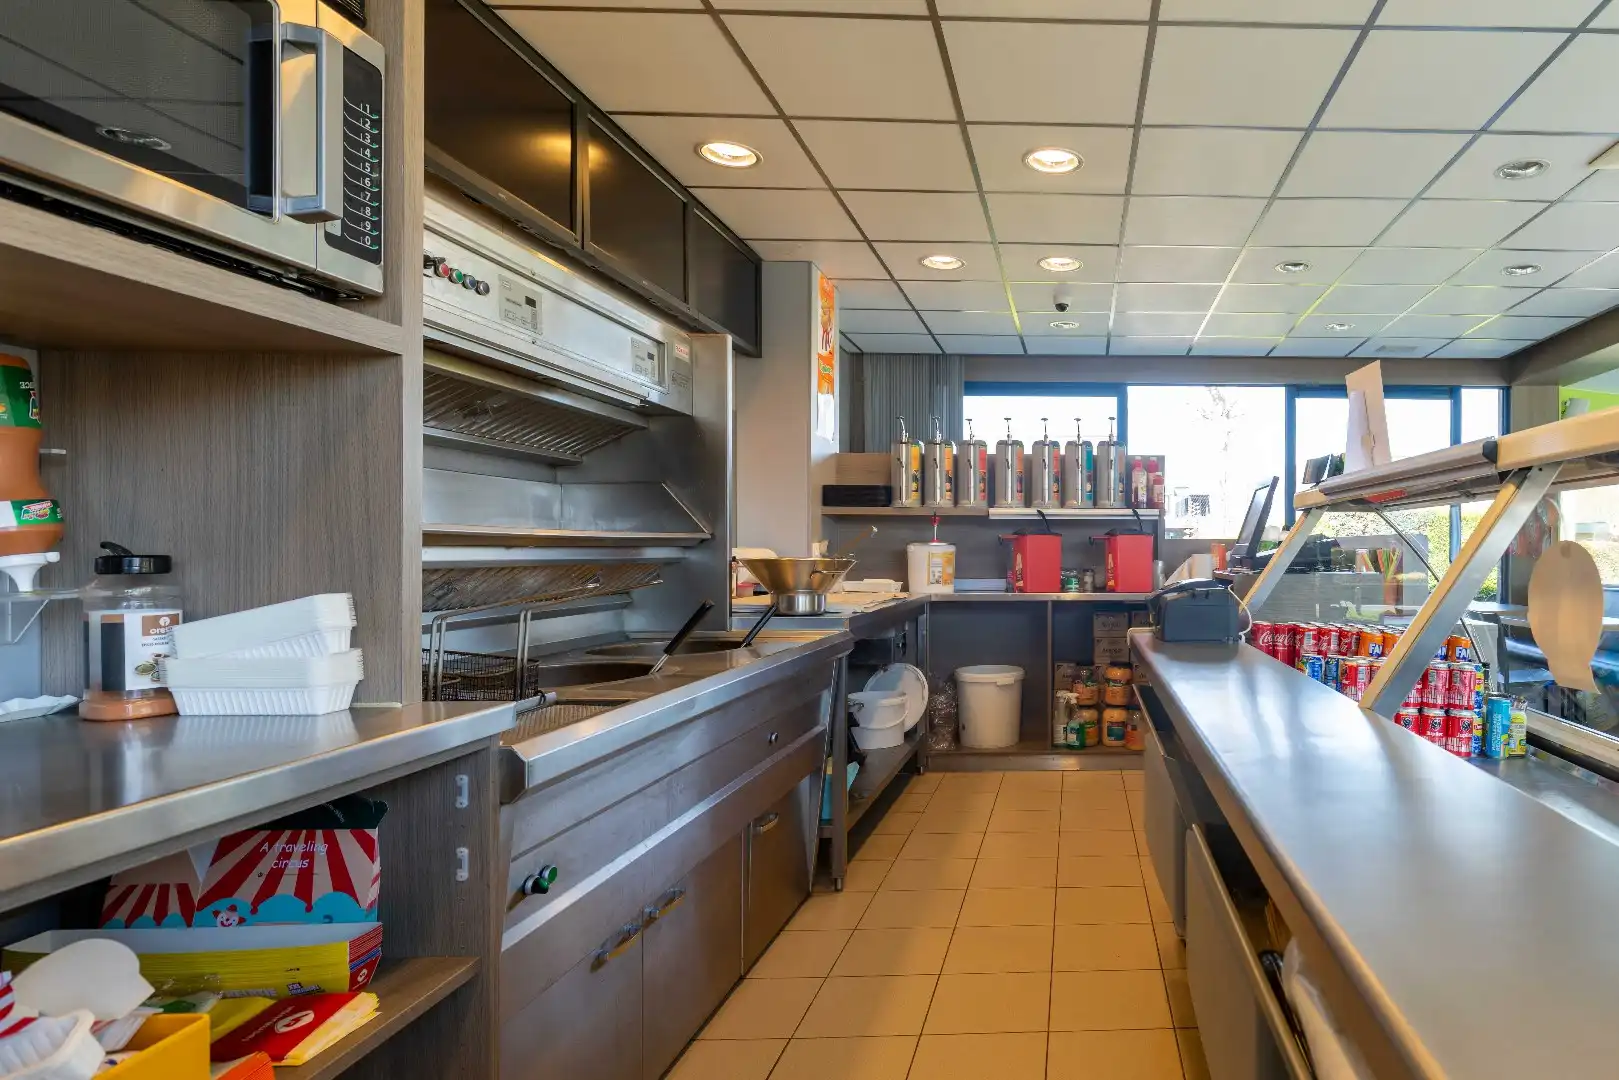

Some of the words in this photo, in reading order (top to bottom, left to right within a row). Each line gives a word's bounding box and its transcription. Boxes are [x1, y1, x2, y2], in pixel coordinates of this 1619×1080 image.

[365, 104, 371, 113] 1
[365, 119, 371, 129] 2
[365, 133, 371, 143] 3
[365, 149, 371, 158] 4
[365, 163, 371, 172] 5
[365, 177, 371, 187] 6
[365, 192, 371, 201] 7
[365, 207, 371, 216] 8
[365, 221, 371, 231] 9
[365, 236, 371, 245] 0
[260, 842, 269, 853] A
[274, 840, 329, 856] traveling
[271, 858, 310, 869] circus
